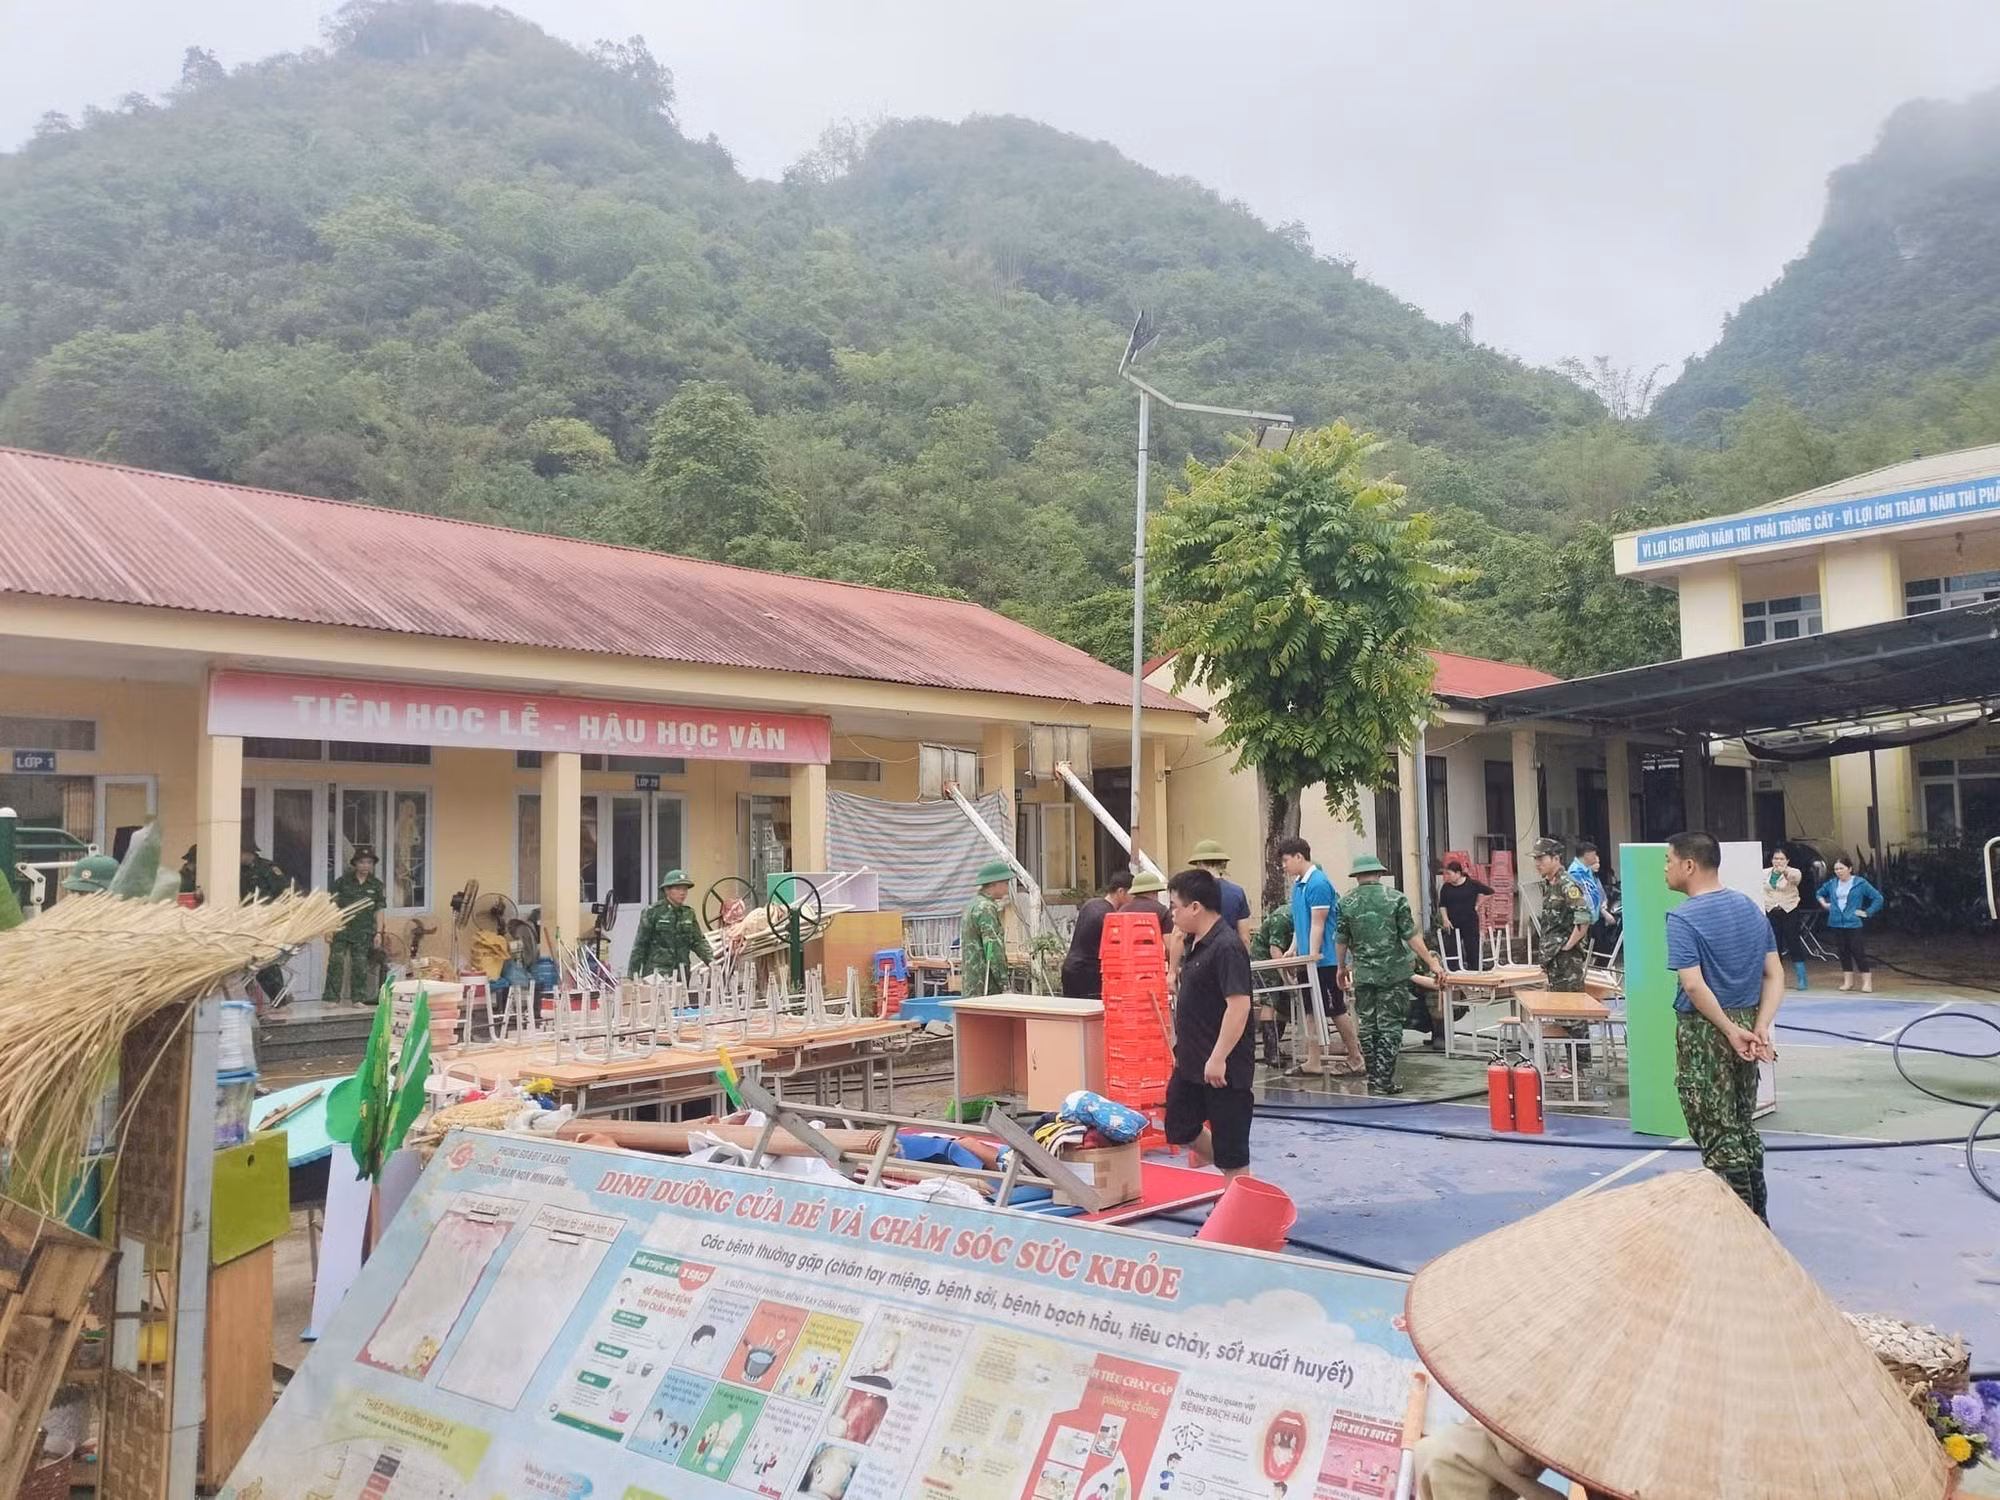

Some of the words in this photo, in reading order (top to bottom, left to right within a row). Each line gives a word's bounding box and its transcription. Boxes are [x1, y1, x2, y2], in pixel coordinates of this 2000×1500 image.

[1642, 541, 1651, 558] VÌ
[1653, 540, 1667, 558] LỢI
[1669, 535, 1684, 553] ÍCH
[1686, 529, 1710, 550] MƯỜI
[1712, 527, 1734, 547] NĂM
[1736, 523, 1751, 543] THÌ
[1754, 517, 1777, 539] PHẢI
[1779, 513, 1812, 536] TRỒNG
[1814, 510, 1834, 530] CÂY
[1842, 506, 1852, 526] VÌ
[1855, 504, 1872, 526] LỢI
[1875, 500, 1893, 521] ÍCH
[1894, 496, 1927, 517] TRĂM
[1929, 491, 1957, 512] NĂM
[1958, 486, 1977, 508] THÌ
[292, 692, 391, 729] TIÊN
[406, 702, 485, 735] HỌC
[501, 702, 541, 738] LỄ
[580, 712, 646, 748] HẬU
[657, 720, 719, 751] HỌC
[728, 721, 786, 751] VĂN
[16, 753, 43, 768] LỚP
[47, 757, 54, 768] 1
[596, 1171, 656, 1200] DINH
[653, 1178, 734, 1214] DƯỠNG
[735, 1187, 784, 1223] CỦA
[788, 1197, 827, 1229] BÉ
[830, 1205, 866, 1238] VÀ
[869, 1213, 953, 1253] CHĂM
[953, 1226, 1014, 1264] SÓC
[1015, 1238, 1082, 1279] SỨC
[1085, 1251, 1183, 1301] KHỎE
[701, 1233, 726, 1250] Các
[726, 1239, 755, 1258] bệnh
[796, 1252, 824, 1272] gặp
[864, 1265, 888, 1286] tay
[887, 1270, 932, 1297] miệng,
[936, 1279, 972, 1302] bệnh
[973, 1288, 998, 1308] sởi,
[1001, 1293, 1042, 1318] bệnh
[1043, 1304, 1087, 1329] bạch
[1089, 1311, 1124, 1340] hầu,
[1129, 1321, 1161, 1345] tiêu
[1165, 1331, 1211, 1360] chảy,
[1216, 1338, 1244, 1363] sốt
[1246, 1347, 1290, 1371] xuất
[1292, 1356, 1355, 1390] huyết)
